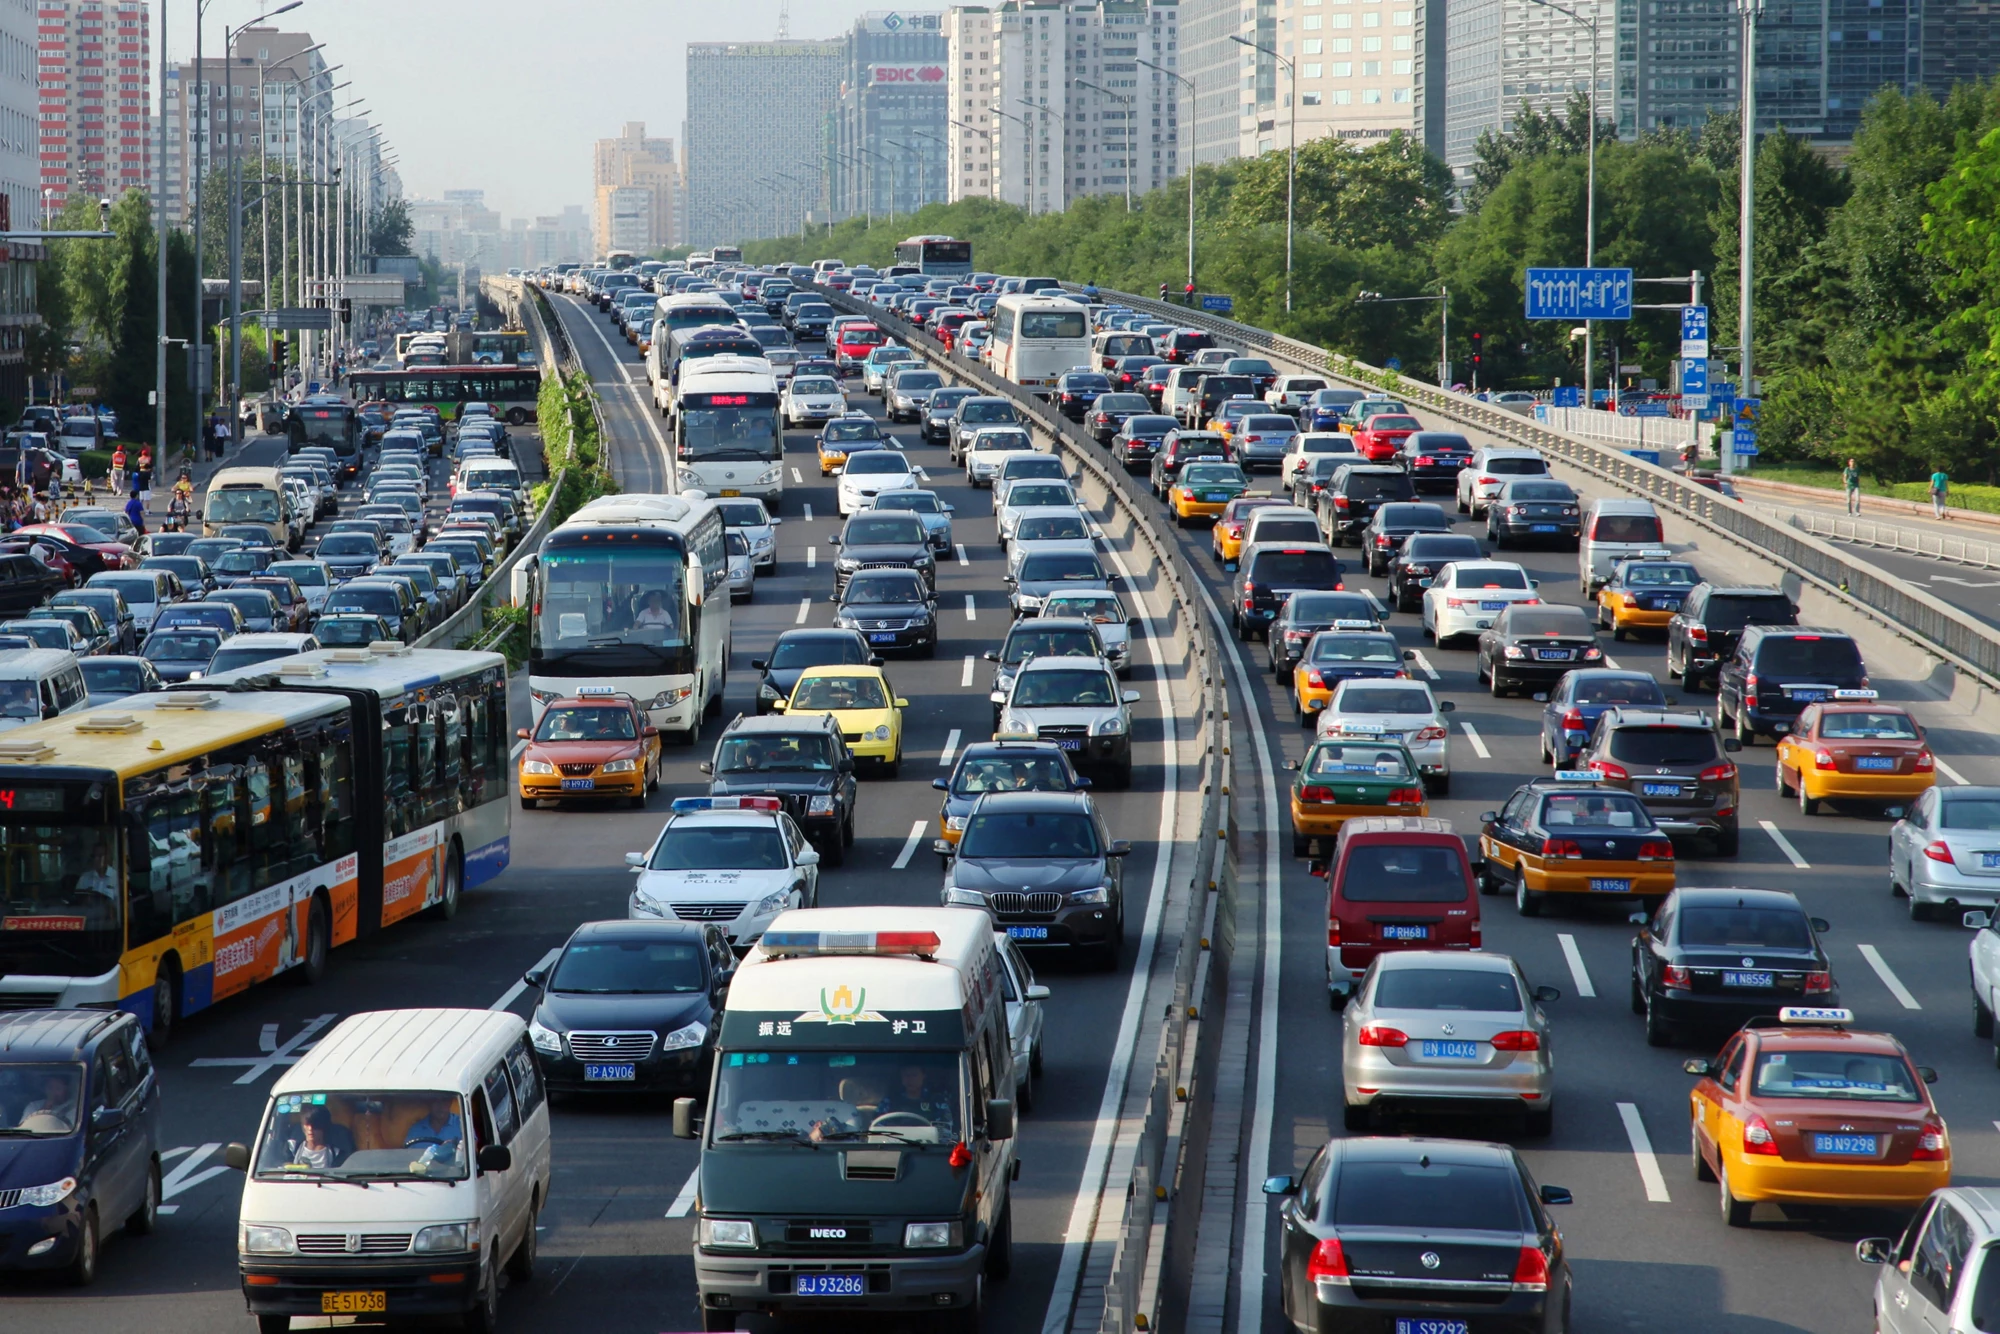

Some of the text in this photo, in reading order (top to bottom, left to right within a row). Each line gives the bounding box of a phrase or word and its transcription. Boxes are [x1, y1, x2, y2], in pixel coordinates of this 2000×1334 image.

[908, 15, 943, 29] 中国
[875, 67, 915, 82] SDIC
[1336, 128, 1418, 139] INTERCONTINTAL
[1684, 308, 1696, 320] P
[1684, 360, 1696, 374] P
[1840, 690, 1875, 698] TAXI
[1561, 771, 1601, 780] TAXI
[0, 790, 16, 809] 4
[1789, 1008, 1845, 1020] TAXI
[758, 1019, 928, 1036] 振远 护卫
[809, 1228, 847, 1239] IVECO
